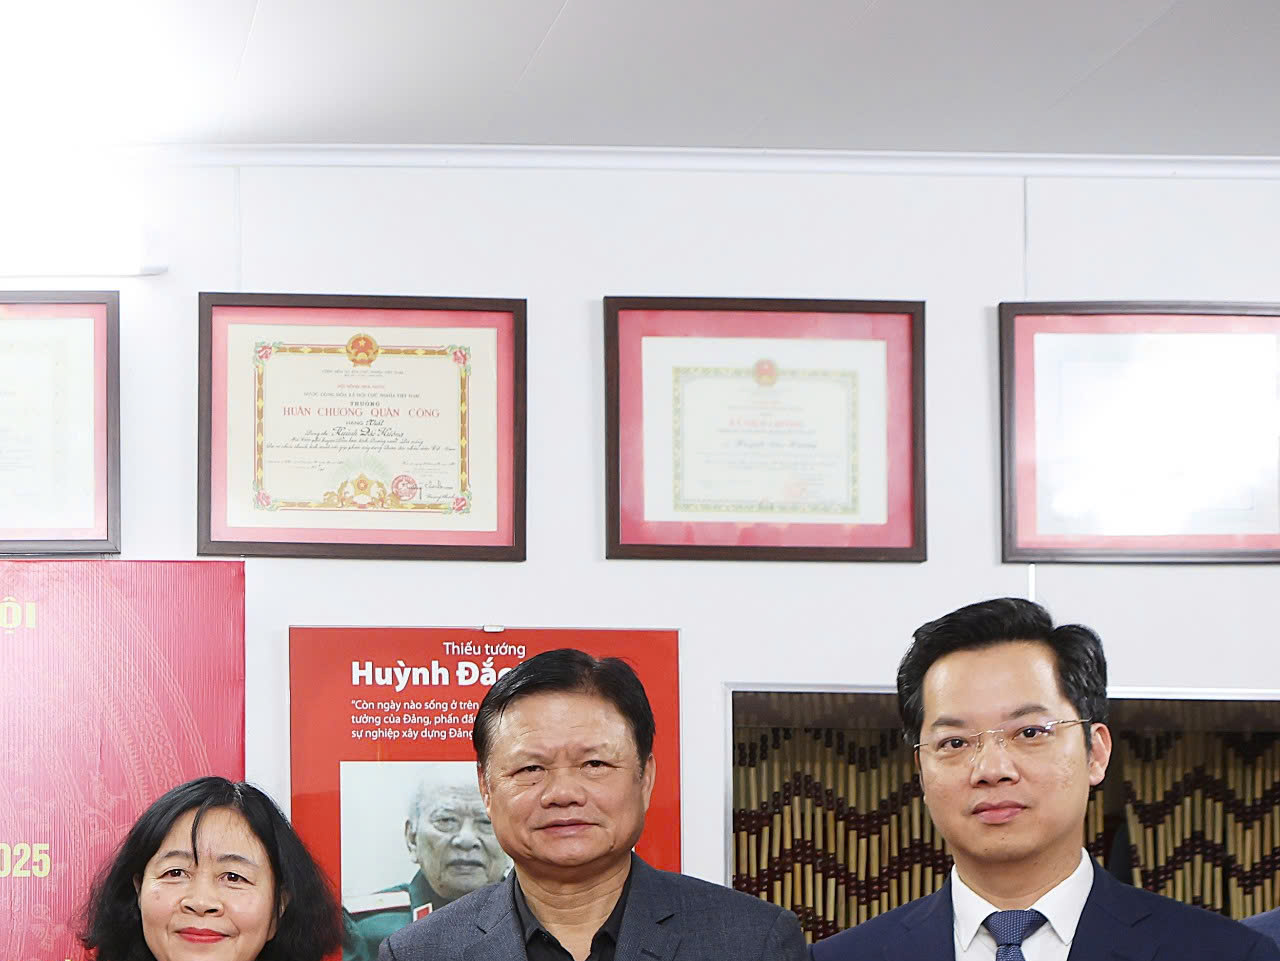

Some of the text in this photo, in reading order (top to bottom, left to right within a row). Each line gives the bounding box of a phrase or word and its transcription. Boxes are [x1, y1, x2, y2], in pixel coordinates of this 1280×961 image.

[442, 641, 526, 659] Thiếu tướng
[351, 660, 450, 693] Huỳnh
[376, 700, 402, 712] ngày
[403, 700, 422, 710] nào
[424, 699, 449, 712] sống
[450, 700, 458, 710] ở
[459, 700, 480, 710] trên
[351, 714, 382, 725] tưởng
[383, 714, 401, 724] của
[403, 713, 432, 725] Đảng,
[434, 713, 460, 725] phấn
[351, 730, 364, 740] sự
[365, 728, 400, 740] nghiệp
[401, 728, 419, 740] xây
[420, 728, 447, 740] dựng
